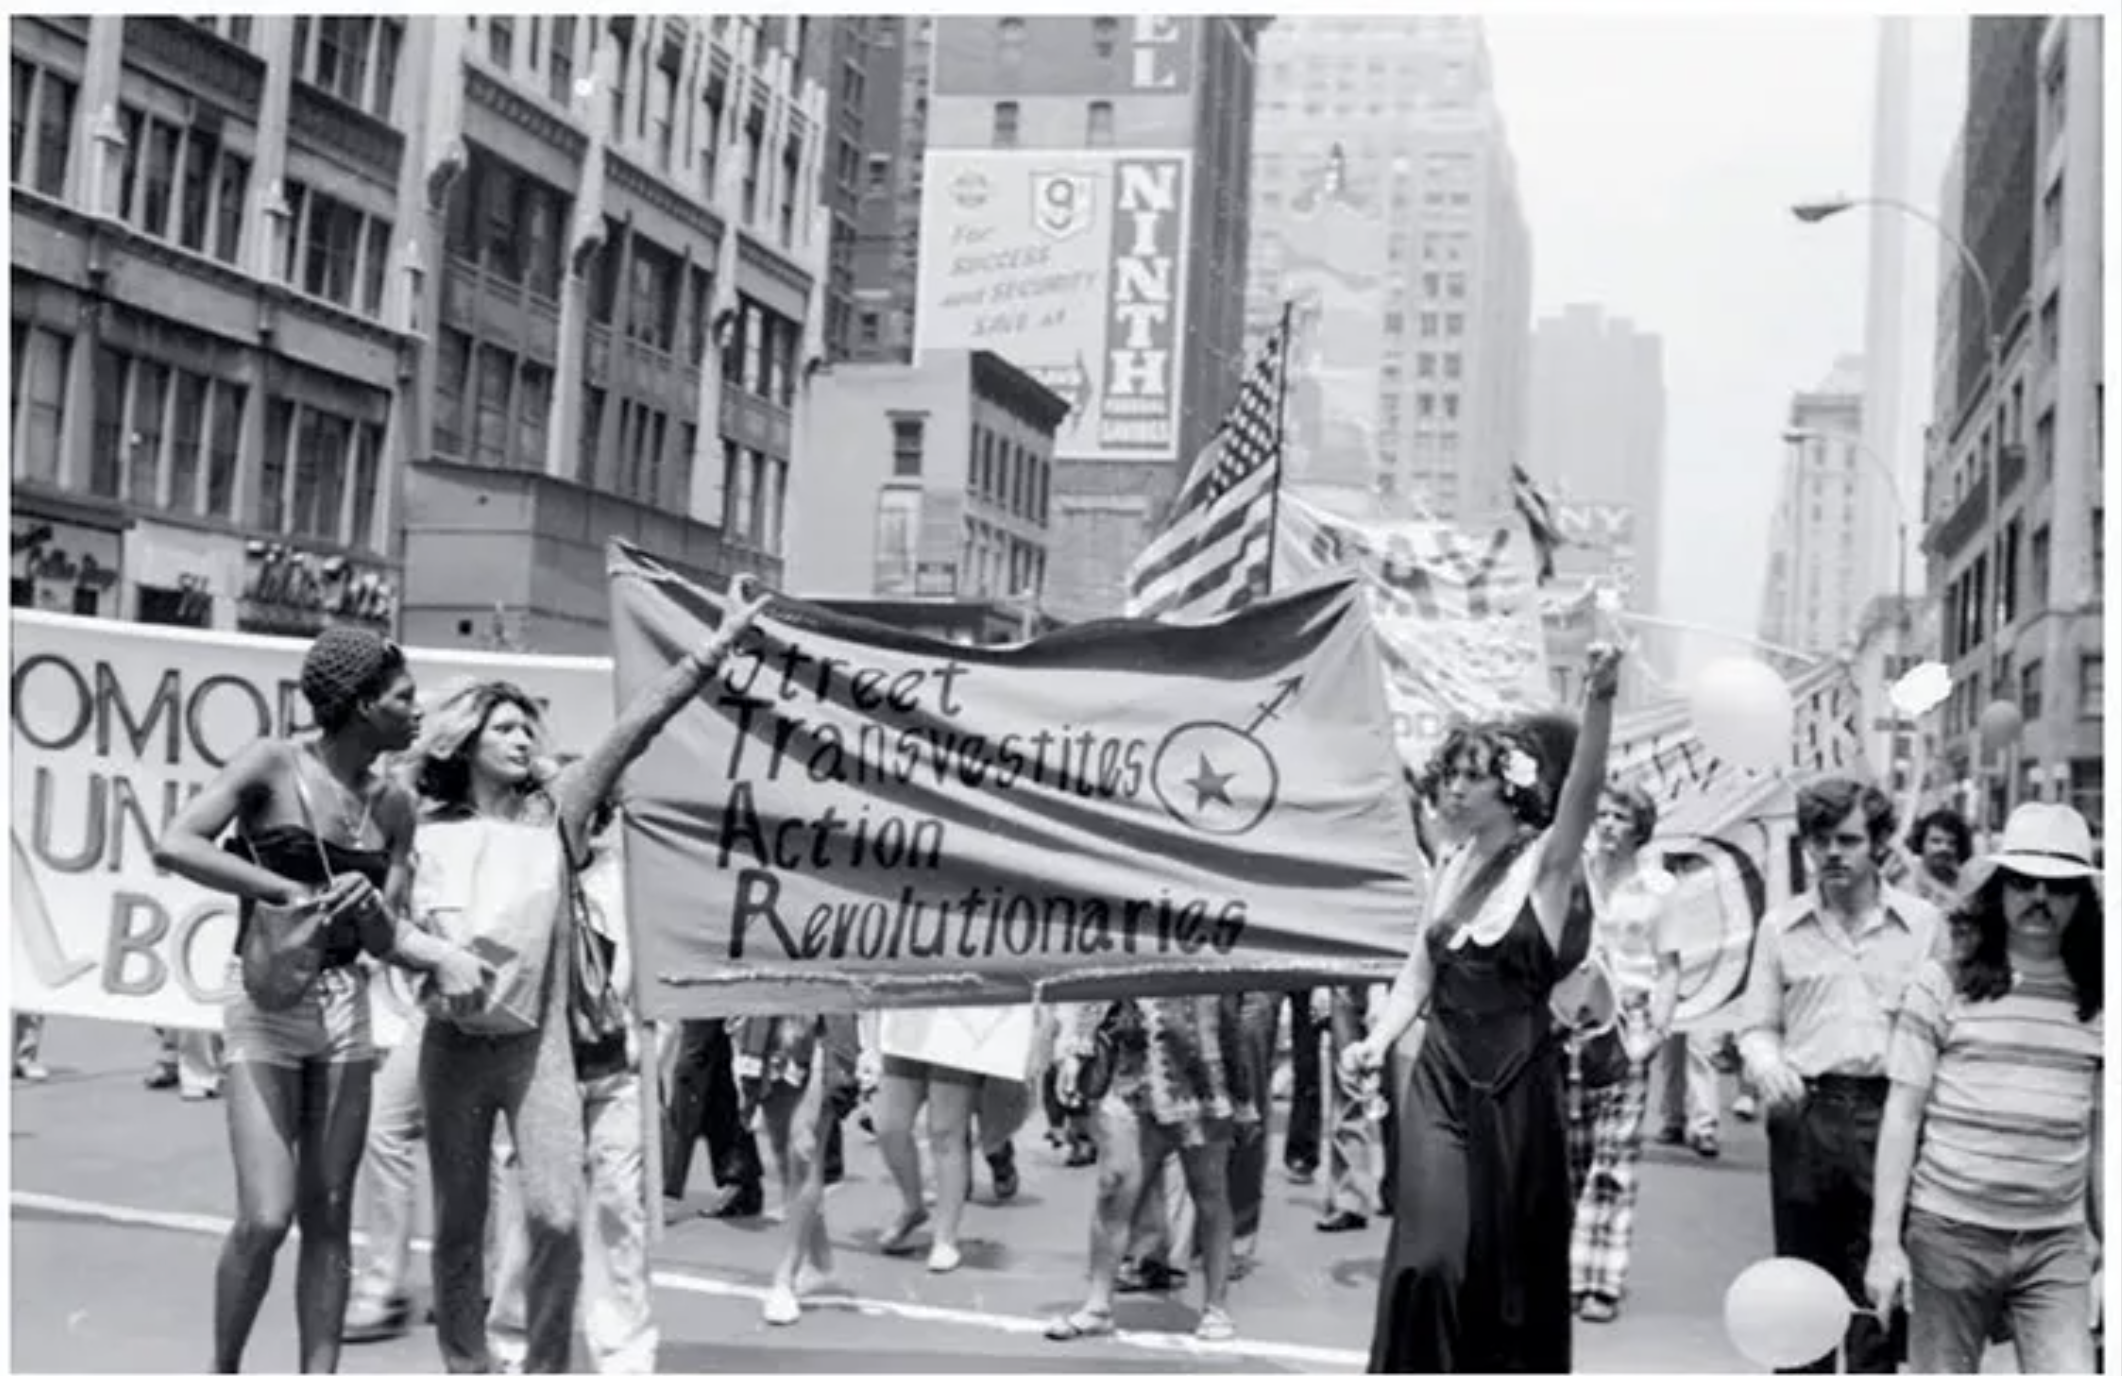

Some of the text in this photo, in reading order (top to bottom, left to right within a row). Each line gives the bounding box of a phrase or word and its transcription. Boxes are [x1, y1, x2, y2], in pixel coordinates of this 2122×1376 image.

[1045, 178, 1075, 231] 9
[949, 244, 1051, 276] SUCCESS
[990, 270, 1099, 303] SECURITY
[1110, 164, 1178, 395] NINTH
[723, 624, 968, 716] Street
[717, 695, 1146, 798] Transvestites
[716, 780, 945, 868] Action
[727, 867, 1247, 960] Revolutionaries
